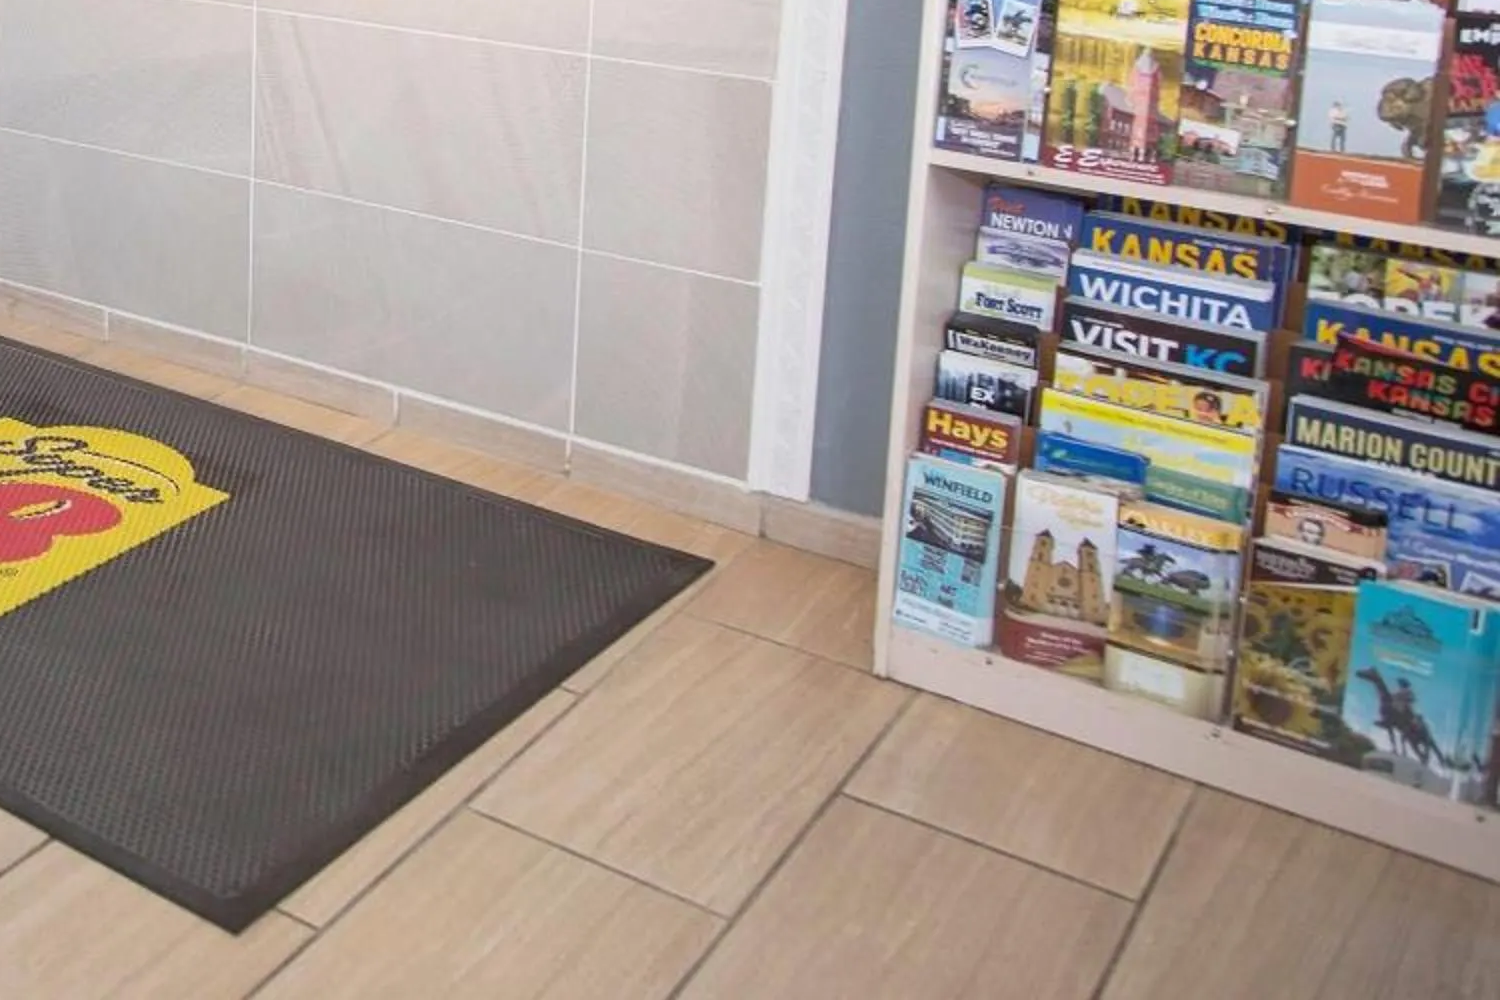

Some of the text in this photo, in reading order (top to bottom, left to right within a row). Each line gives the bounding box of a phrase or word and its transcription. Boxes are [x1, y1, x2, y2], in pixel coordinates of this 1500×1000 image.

[1193, 41, 1289, 71] KANSAS
[990, 212, 1060, 238] NEWTON
[1090, 226, 1259, 281] KANSAS
[1079, 272, 1253, 330] WICHITA
[1070, 319, 1247, 373] VISIT KC
[1334, 350, 1458, 395] KANSAS
[1468, 381, 1500, 407] CI
[1368, 379, 1496, 427] KANSAS
[927, 408, 1009, 449] Hays
[1296, 416, 1500, 487] MARION COUNT
[923, 471, 994, 504] WINFIELD
[1291, 467, 1469, 535] RUSSELL
